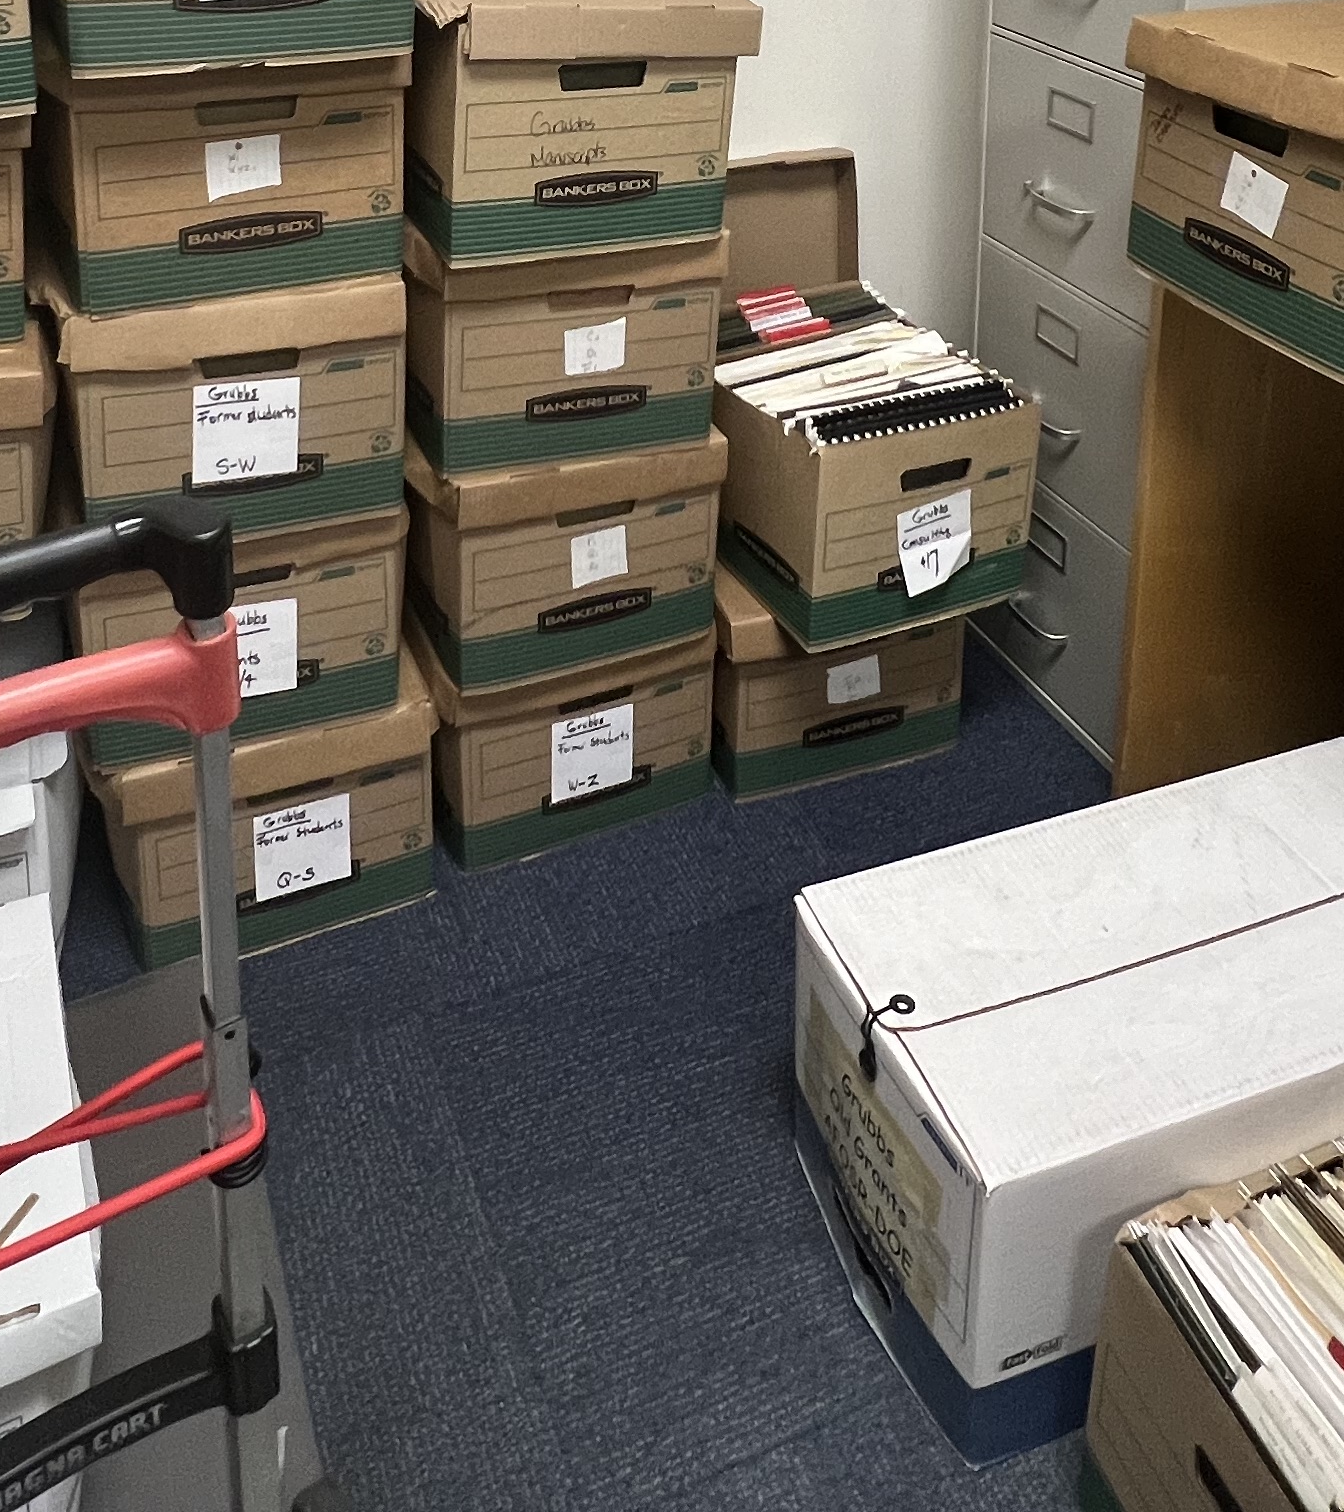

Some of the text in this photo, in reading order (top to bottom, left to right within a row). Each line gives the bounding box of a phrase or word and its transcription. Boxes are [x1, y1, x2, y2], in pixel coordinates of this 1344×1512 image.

[543, 178, 651, 199] BANKERS BOX
[188, 218, 315, 246] BANKERS BOX
[1190, 226, 1283, 282] BANKERS BOX
[208, 384, 259, 401] Grubbs
[533, 392, 640, 415] BANKERS BOX
[215, 454, 257, 475] S-W
[545, 595, 647, 626] BANKERS BOX
[276, 867, 315, 889] Q-S
[841, 1073, 895, 1168] Grubbs
[91, 1402, 169, 1452] CART
